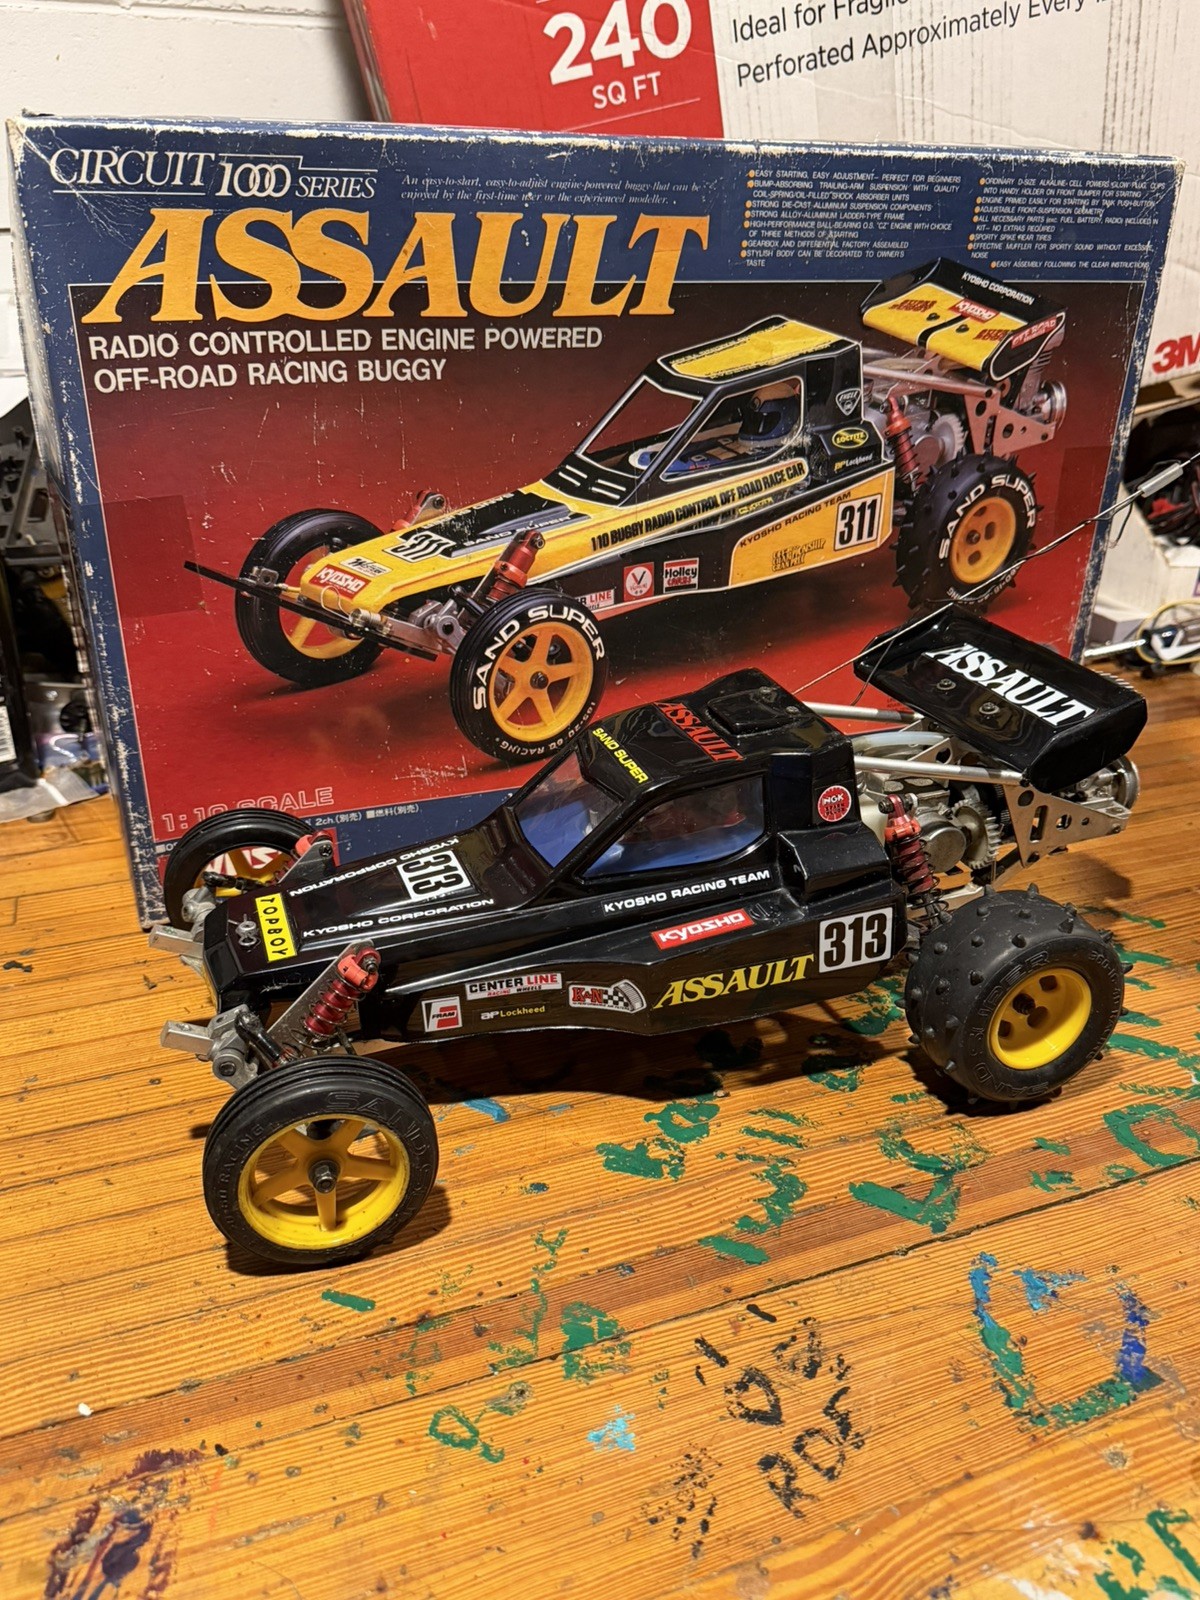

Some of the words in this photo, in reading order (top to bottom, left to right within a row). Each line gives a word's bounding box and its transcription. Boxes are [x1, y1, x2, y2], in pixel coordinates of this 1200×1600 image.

[733, 18, 787, 43] Ideal
[794, 3, 826, 30] for
[543, 0, 692, 85] 240
[737, 37, 854, 87] Perforated
[861, 3, 1021, 58] Approximately
[592, 80, 626, 109] SQ
[633, 71, 661, 100] FT
[50, 147, 215, 187] CIRCUIT
[214, 161, 291, 198] 1000
[295, 176, 378, 199] SERIES
[402, 174, 418, 185] An
[550, 180, 621, 192] engine-powered
[812, 171, 830, 179] EASY
[882, 173, 909, 182] PERFECT
[912, 174, 925, 182] FOR
[927, 175, 961, 183] BEGINNERS
[985, 177, 1015, 186] ORDINARY
[443, 189, 454, 201] by
[456, 190, 471, 200] the
[475, 190, 519, 202] first-time
[574, 192, 627, 204] experienced
[820, 181, 864, 190] TRAILING-ARM
[869, 182, 908, 191] SUSPENSION
[913, 184, 929, 192] WITH
[933, 184, 960, 192] QUALITY
[983, 187, 998, 195] INTO
[999, 187, 1020, 195] HANDY
[1021, 188, 1045, 196] HOLDER
[1076, 189, 1100, 197] BUMPER
[1115, 190, 1142, 198] STARTING
[752, 199, 780, 208] STRONG
[850, 202, 888, 211] SUSPENSION
[890, 203, 932, 212] COMPONENTS
[892, 193, 910, 201] UNITS
[1004, 197, 1028, 205] PRIMED
[1028, 197, 1048, 206] EASILY
[1049, 198, 1061, 206] FOR
[750, 210, 778, 218] STRONG
[840, 212, 881, 220] LADDER-TYPE
[979, 215, 989, 223] ALL
[991, 215, 1026, 223] NECESSARY
[980, 206, 1016, 214] ADJUSTABLE
[761, 230, 782, 239] THREE
[890, 222, 912, 230] ENGINE
[930, 223, 952, 231] CHOICE
[1027, 225, 1056, 233] REQUIRED
[747, 240, 779, 248] GEARBOX
[841, 241, 871, 249] FACTORY
[872, 241, 909, 249] ASSEMBLED
[973, 242, 1003, 250] EFFECTIVE
[1005, 242, 1033, 250] MUFFLER
[1034, 243, 1047, 251] FOR
[1050, 243, 1072, 251] SPORTY
[1074, 243, 1094, 251] SOUND
[1096, 243, 1122, 251] WITHOUT
[975, 233, 998, 241] SPORTY
[1035, 234, 1052, 242] TIRES
[745, 259, 766, 267] TASTE
[746, 250, 773, 258] STYLISH
[776, 250, 795, 258] BODY
[797, 250, 811, 258] CAN
[825, 250, 862, 258] DECORATED
[81, 207, 711, 324] ASSAULT
[996, 260, 1012, 268] EASY
[1013, 260, 1042, 268] ASSEMBLY
[1044, 261, 1077, 269] FOLLOWING
[1091, 261, 1110, 269] CLEAR
[961, 271, 990, 289] KYOSHO
[987, 283, 1036, 305] CORPORATION
[955, 300, 998, 320] KYOSHO
[88, 333, 180, 360] RADIO
[188, 330, 373, 357] CONTROLLED
[381, 328, 480, 352] ENGINE
[484, 326, 603, 350] POWERED
[1152, 334, 1200, 374] 3M
[94, 364, 239, 394] OFF-ROAD
[248, 360, 352, 386] RACING
[357, 357, 448, 383] BUGGY
[836, 431, 866, 445] LOCTITE
[610, 523, 645, 546] BUGGY
[644, 514, 676, 537] RADIO
[675, 501, 720, 526] CONTROL
[720, 490, 736, 511] OFF
[736, 482, 765, 502] ROAD
[763, 471, 786, 494] RACE
[785, 460, 806, 482] CAR
[739, 521, 782, 548] KYOSHO
[783, 502, 823, 526] RACING
[823, 490, 852, 510] TEAM
[838, 498, 878, 545] 311
[938, 483, 986, 559] SAND
[990, 473, 1036, 529] SUPER
[390, 532, 448, 560] 311
[463, 530, 512, 547] SAND
[316, 566, 367, 593] KYOSHO
[664, 566, 699, 579] Holley
[589, 590, 612, 603] LINE
[472, 619, 521, 711] SAND
[527, 604, 606, 661] SUPER
[923, 642, 1096, 727] ASSAULT
[652, 702, 746, 763] ASSAULT
[499, 740, 545, 756] RACING
[592, 727, 620, 750] SAND
[613, 748, 650, 784] SUPER
[400, 836, 460, 861] KYOSHO
[289, 857, 398, 898] CORPORATION
[402, 853, 466, 897] 313
[603, 891, 667, 914] KYOSHO
[670, 878, 727, 900] RACING
[728, 869, 771, 886] TEAM
[302, 919, 374, 939] KYOSHO
[377, 898, 495, 924] CORPORATION
[658, 912, 746, 943] KYOSHO
[823, 912, 889, 968] 313
[469, 977, 524, 994] CENTER
[526, 973, 558, 986] LINE
[653, 952, 815, 1010] ASSAULT
[571, 986, 603, 1004] K&N
[431, 1010, 457, 1020] FRAM
[500, 1005, 546, 1018] Lockheed
